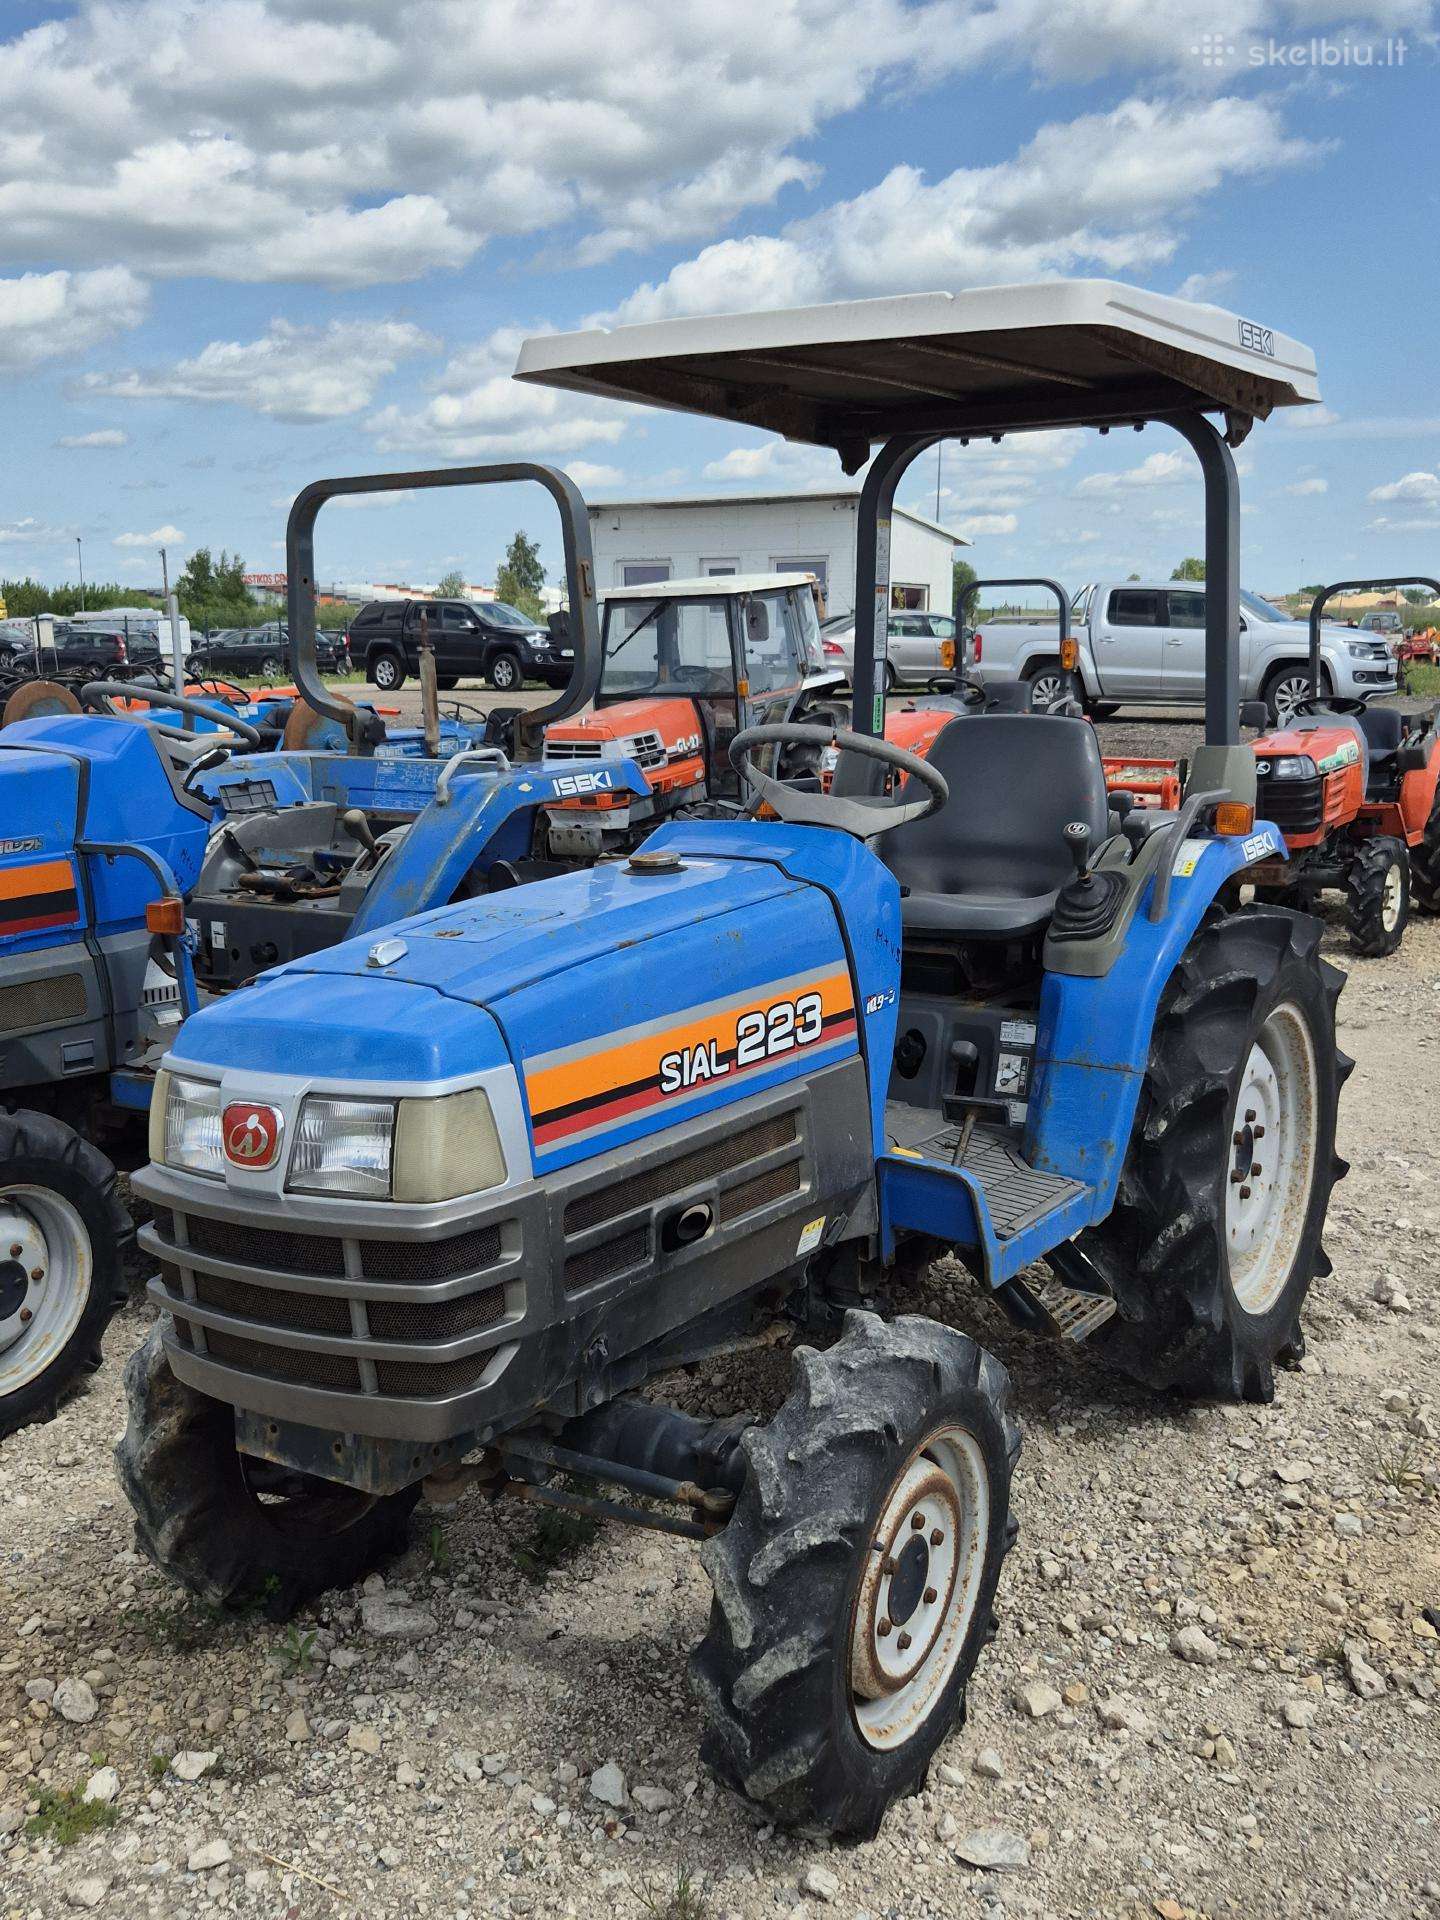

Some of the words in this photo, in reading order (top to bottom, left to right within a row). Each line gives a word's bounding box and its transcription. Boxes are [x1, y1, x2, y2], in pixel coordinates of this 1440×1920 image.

[1238, 318, 1275, 357] ISEKI
[552, 770, 613, 797] ISEKI
[1241, 831, 1276, 862] ISEKI
[660, 1041, 729, 1094] SIAL
[736, 992, 823, 1068] 223
